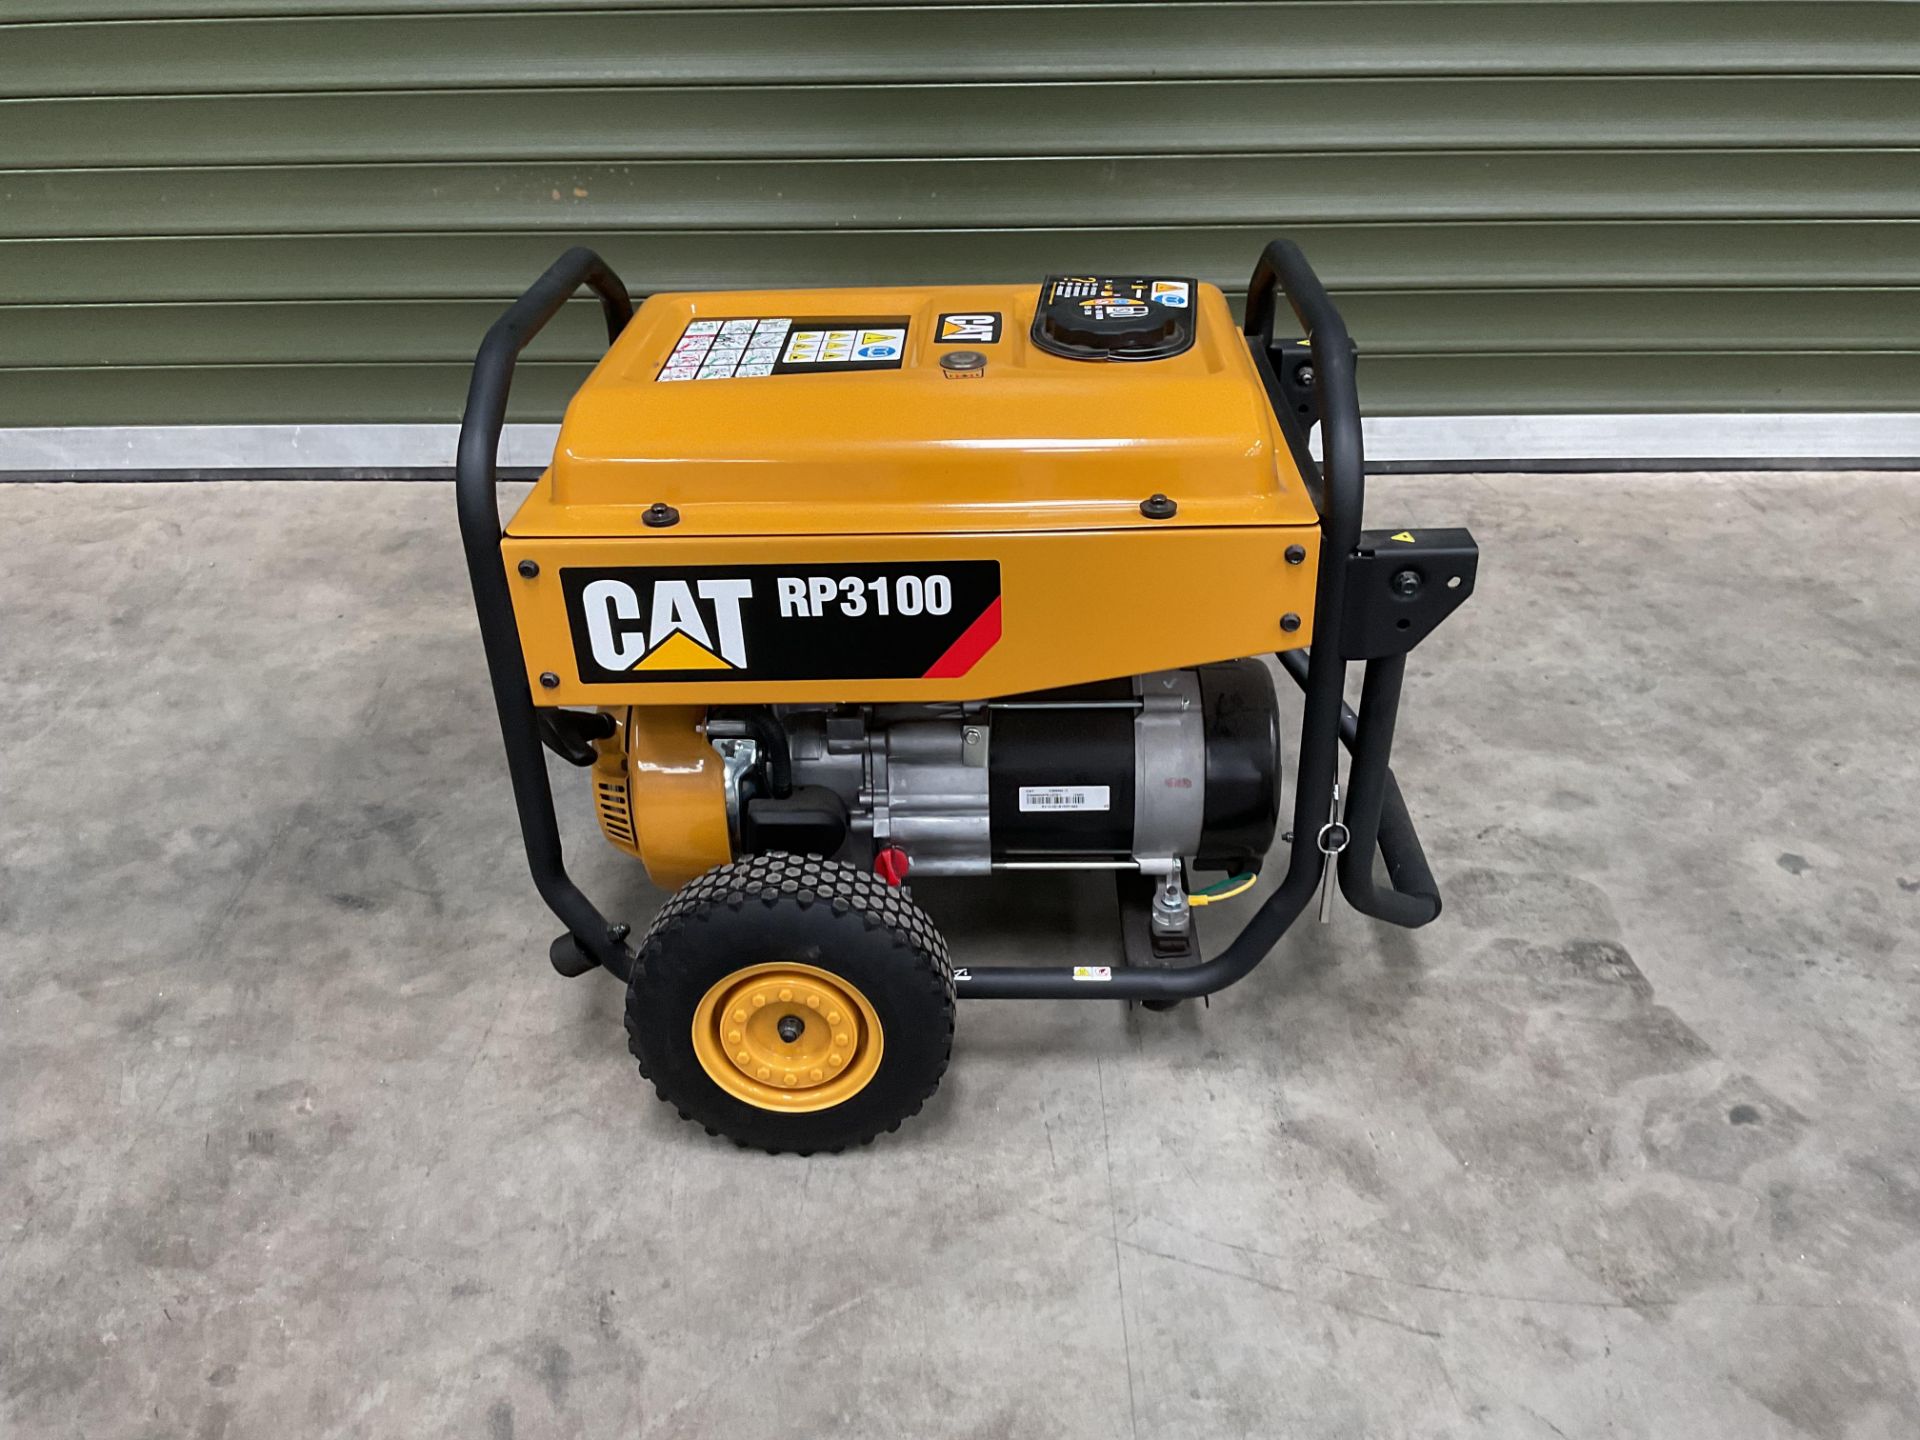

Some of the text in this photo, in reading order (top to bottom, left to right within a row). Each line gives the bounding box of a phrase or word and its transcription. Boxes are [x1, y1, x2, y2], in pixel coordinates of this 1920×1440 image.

[942, 315, 995, 341] CAT
[582, 575, 952, 671] CAT RP3100
